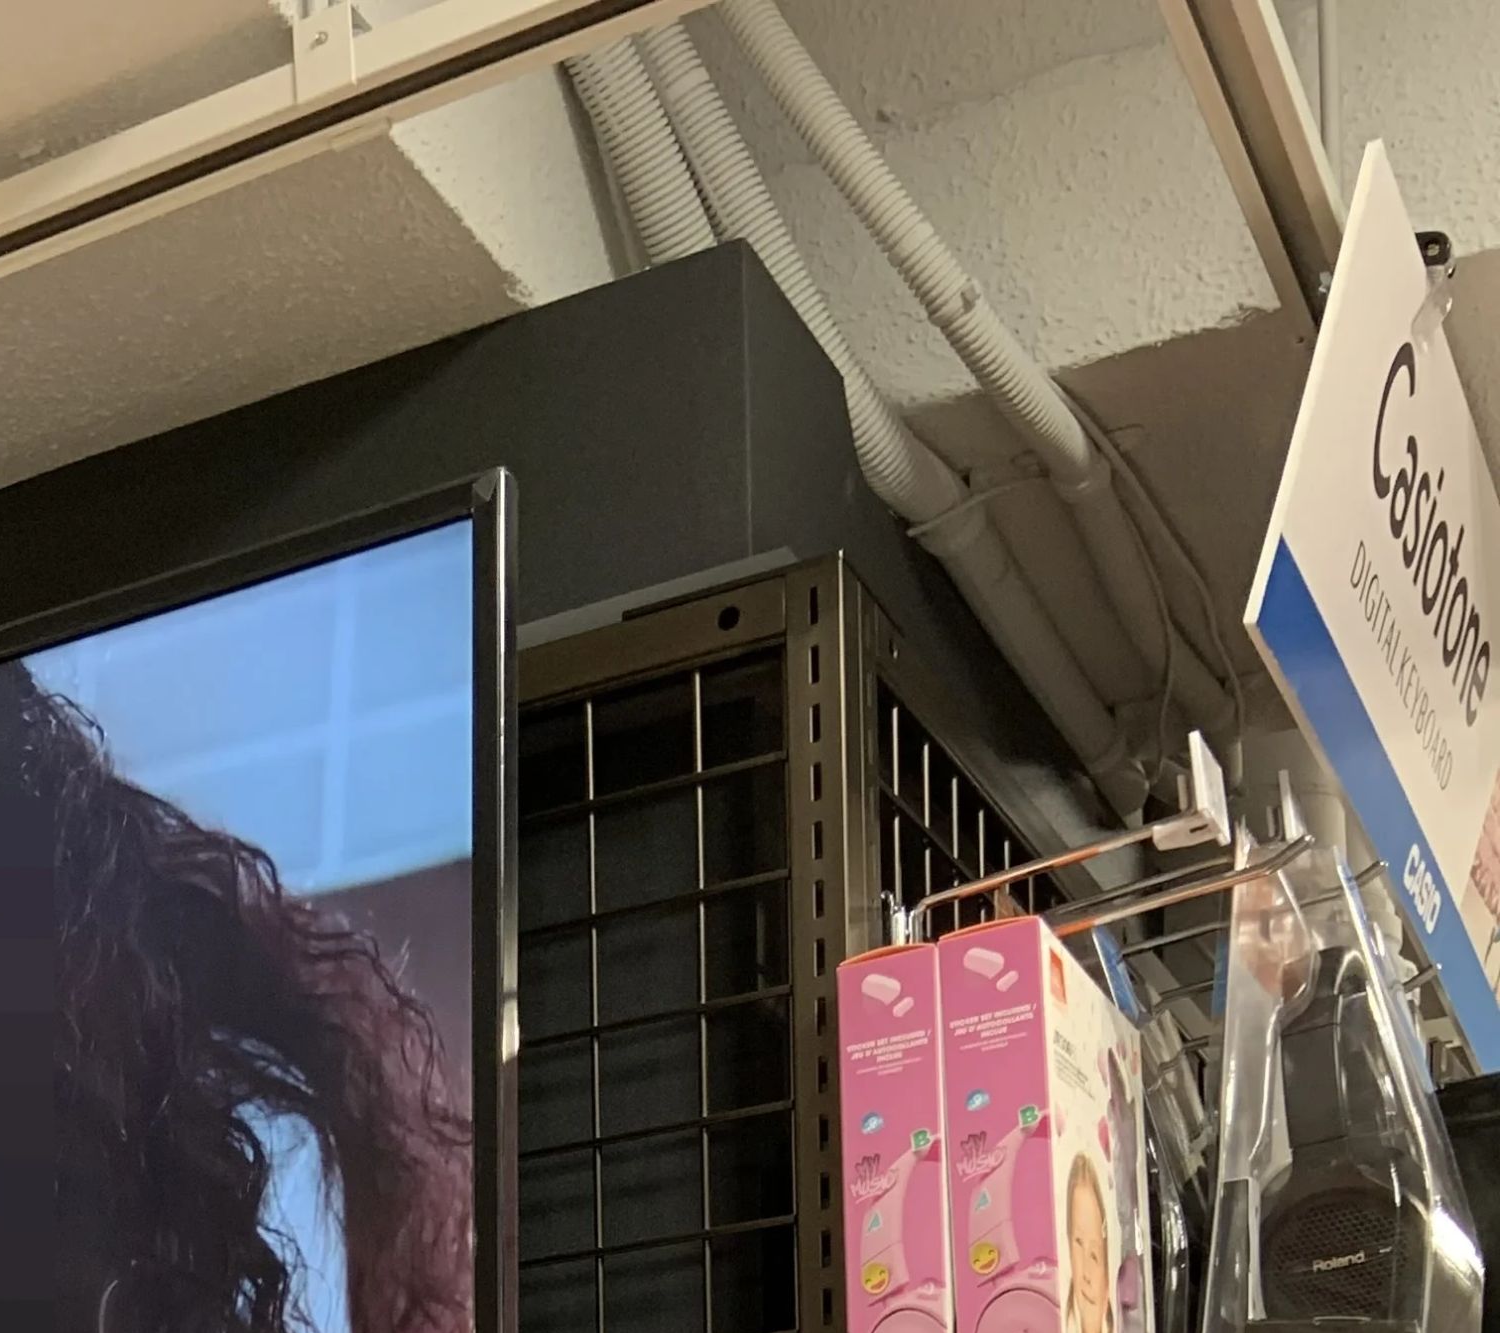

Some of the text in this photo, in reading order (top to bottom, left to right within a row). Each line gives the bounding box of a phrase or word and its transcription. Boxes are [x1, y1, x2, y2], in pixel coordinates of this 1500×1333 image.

[1373, 341, 1490, 727] Casiotone
[1350, 540, 1453, 790] DIGITAL KEYBOARD
[1403, 843, 1441, 934] CASIO
[1312, 1251, 1365, 1273] Roland
